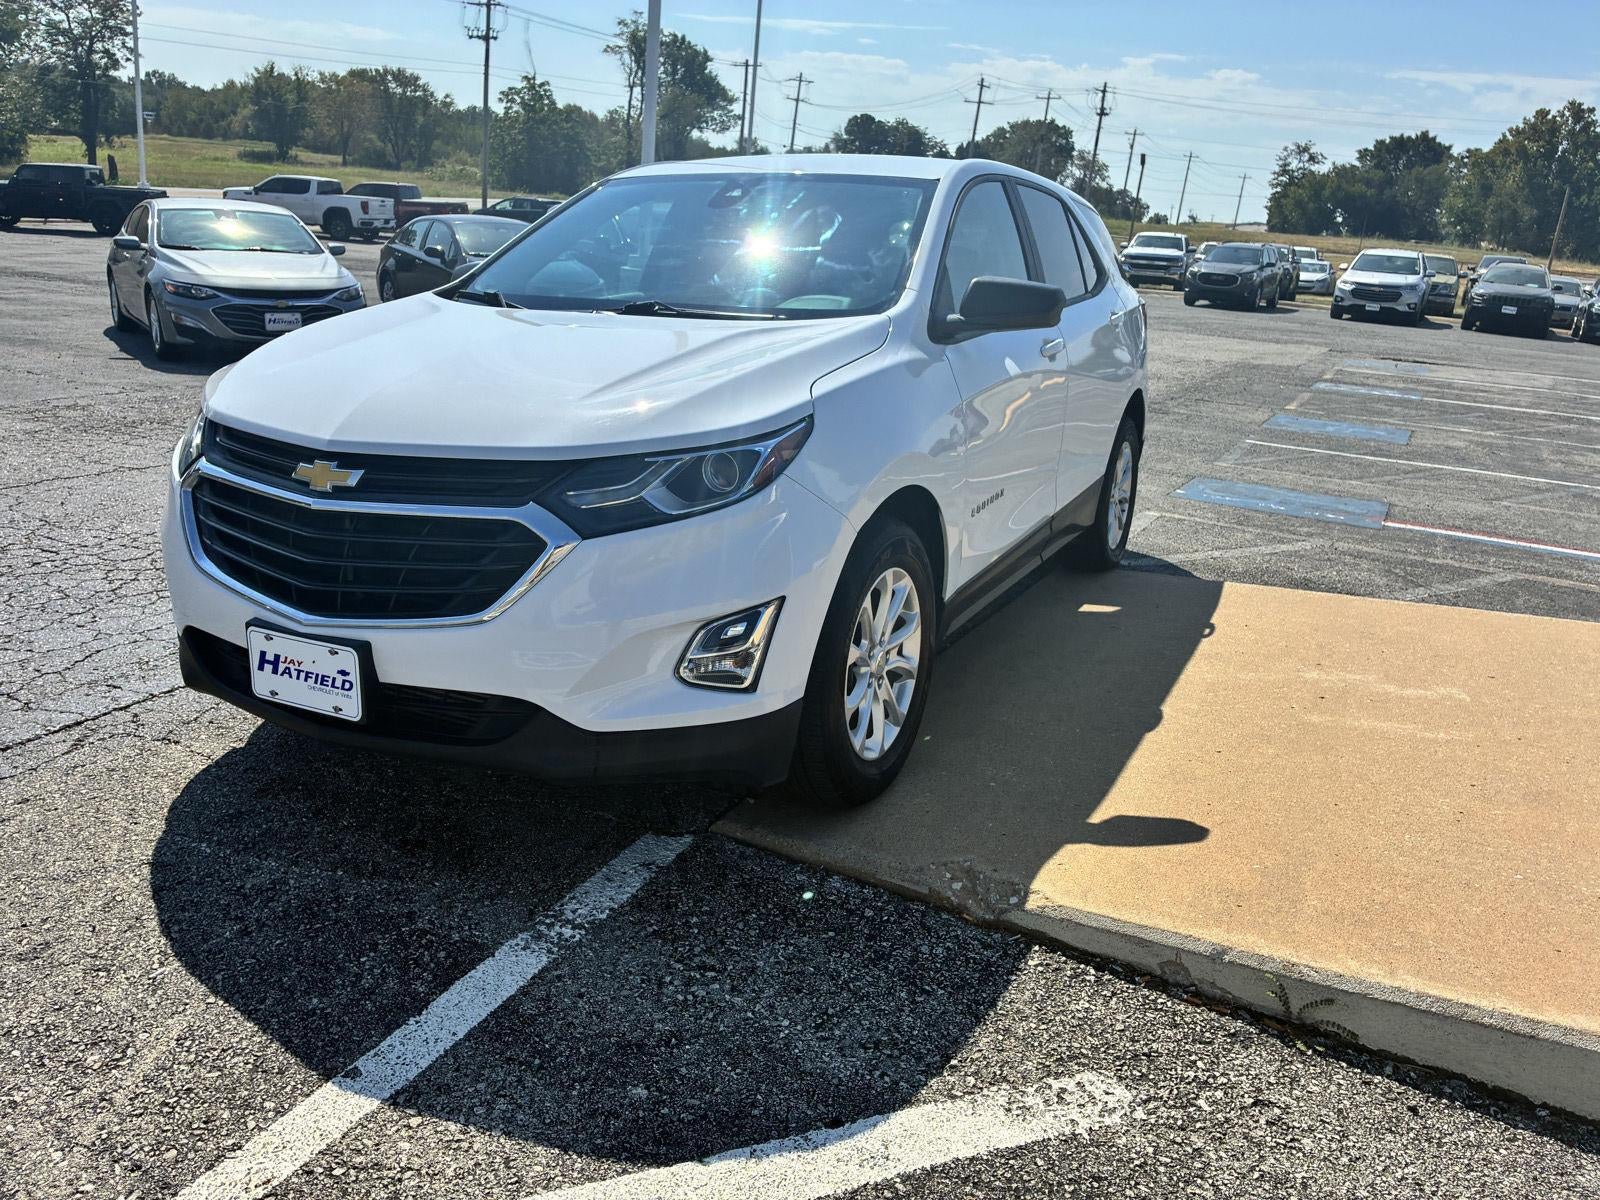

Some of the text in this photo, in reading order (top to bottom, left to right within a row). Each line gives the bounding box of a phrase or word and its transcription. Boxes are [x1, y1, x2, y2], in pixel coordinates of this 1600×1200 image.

[971, 488, 1005, 518] EQUINOX
[257, 650, 354, 691] HATFIELD
[281, 656, 304, 667] JAY
